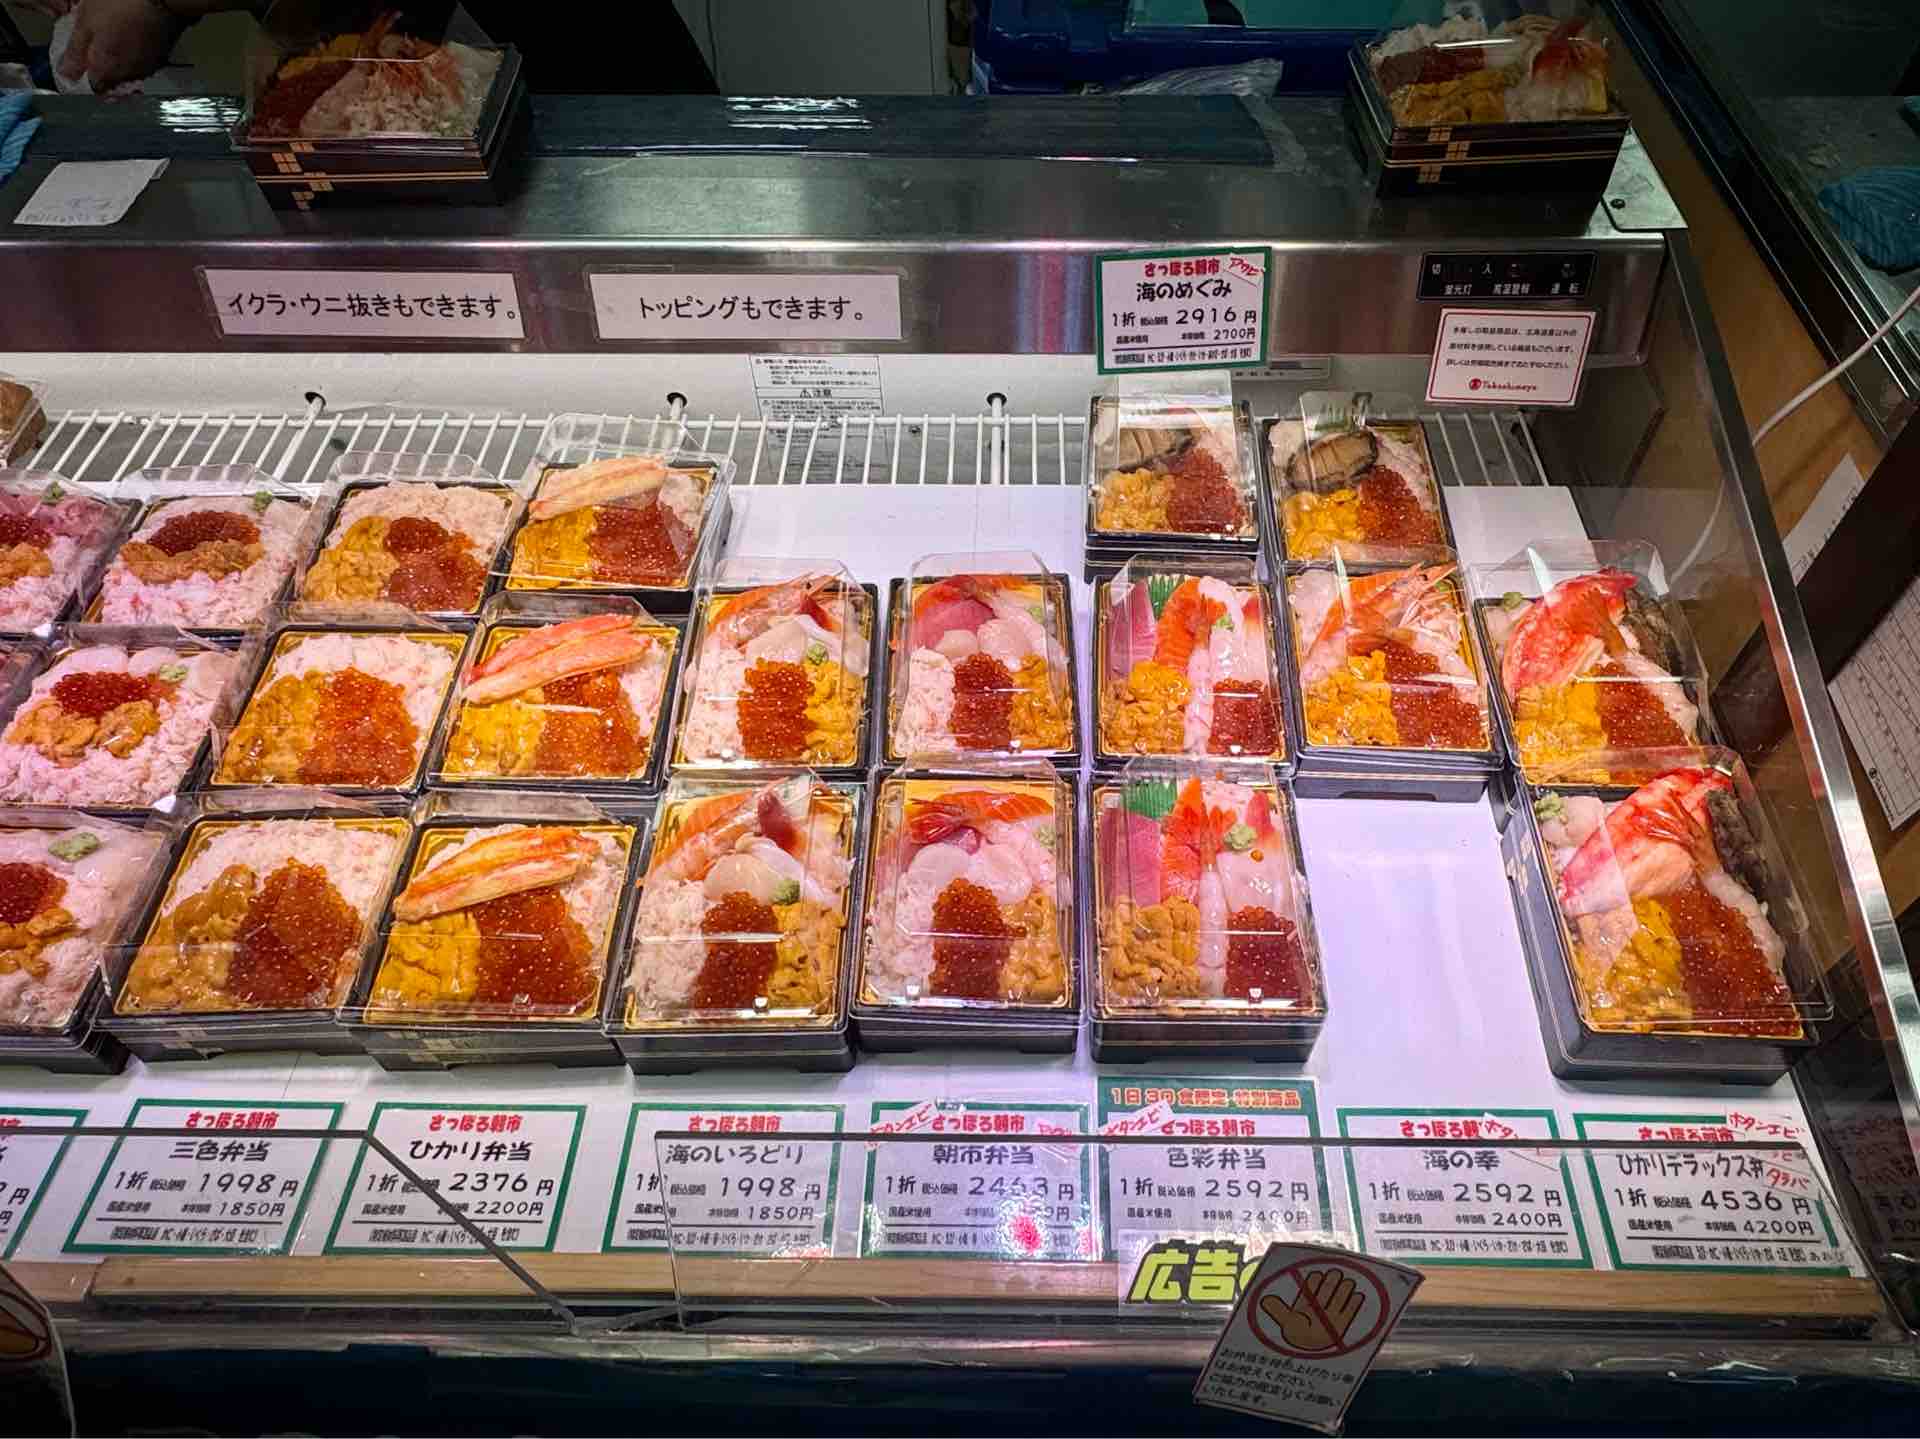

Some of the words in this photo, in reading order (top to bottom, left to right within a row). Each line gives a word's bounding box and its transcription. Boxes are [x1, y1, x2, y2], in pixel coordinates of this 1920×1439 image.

[1136, 278, 1233, 302] 海のめぐみ
[228, 292, 517, 319] イクラ・ウニ抜きもできます。
[639, 295, 864, 321] トッピングもできます。
[1213, 327, 1256, 341] 2700円
[185, 1111, 280, 1129] さっぽろ朝市
[428, 1114, 524, 1133] さっぽろ朝市
[687, 1115, 783, 1133] さっぽろ朝市
[930, 1113, 1026, 1133] さっぽろ朝市
[169, 1139, 272, 1163] 三色弁当
[409, 1139, 534, 1162] ひかり弁当
[664, 1143, 805, 1164] 海のいろどり
[932, 1144, 1035, 1165] 朝市弁当
[1166, 1147, 1267, 1170] 色彩弁当
[1423, 1150, 1501, 1171] 海の幸
[113, 1171, 149, 1191] 1折
[366, 1173, 399, 1193] 1折
[885, 1175, 916, 1196] 1折
[1120, 1177, 1153, 1197] 1折
[1767, 1168, 1810, 1191] タラバ
[1369, 1181, 1400, 1201] 1折
[1614, 1187, 1648, 1208] 1折
[217, 1202, 286, 1217] 1850円
[473, 1201, 544, 1217] 2200円
[747, 1206, 815, 1221] 1850円
[1492, 1213, 1563, 1228] 2400円
[1743, 1219, 1816, 1236] 4200円
